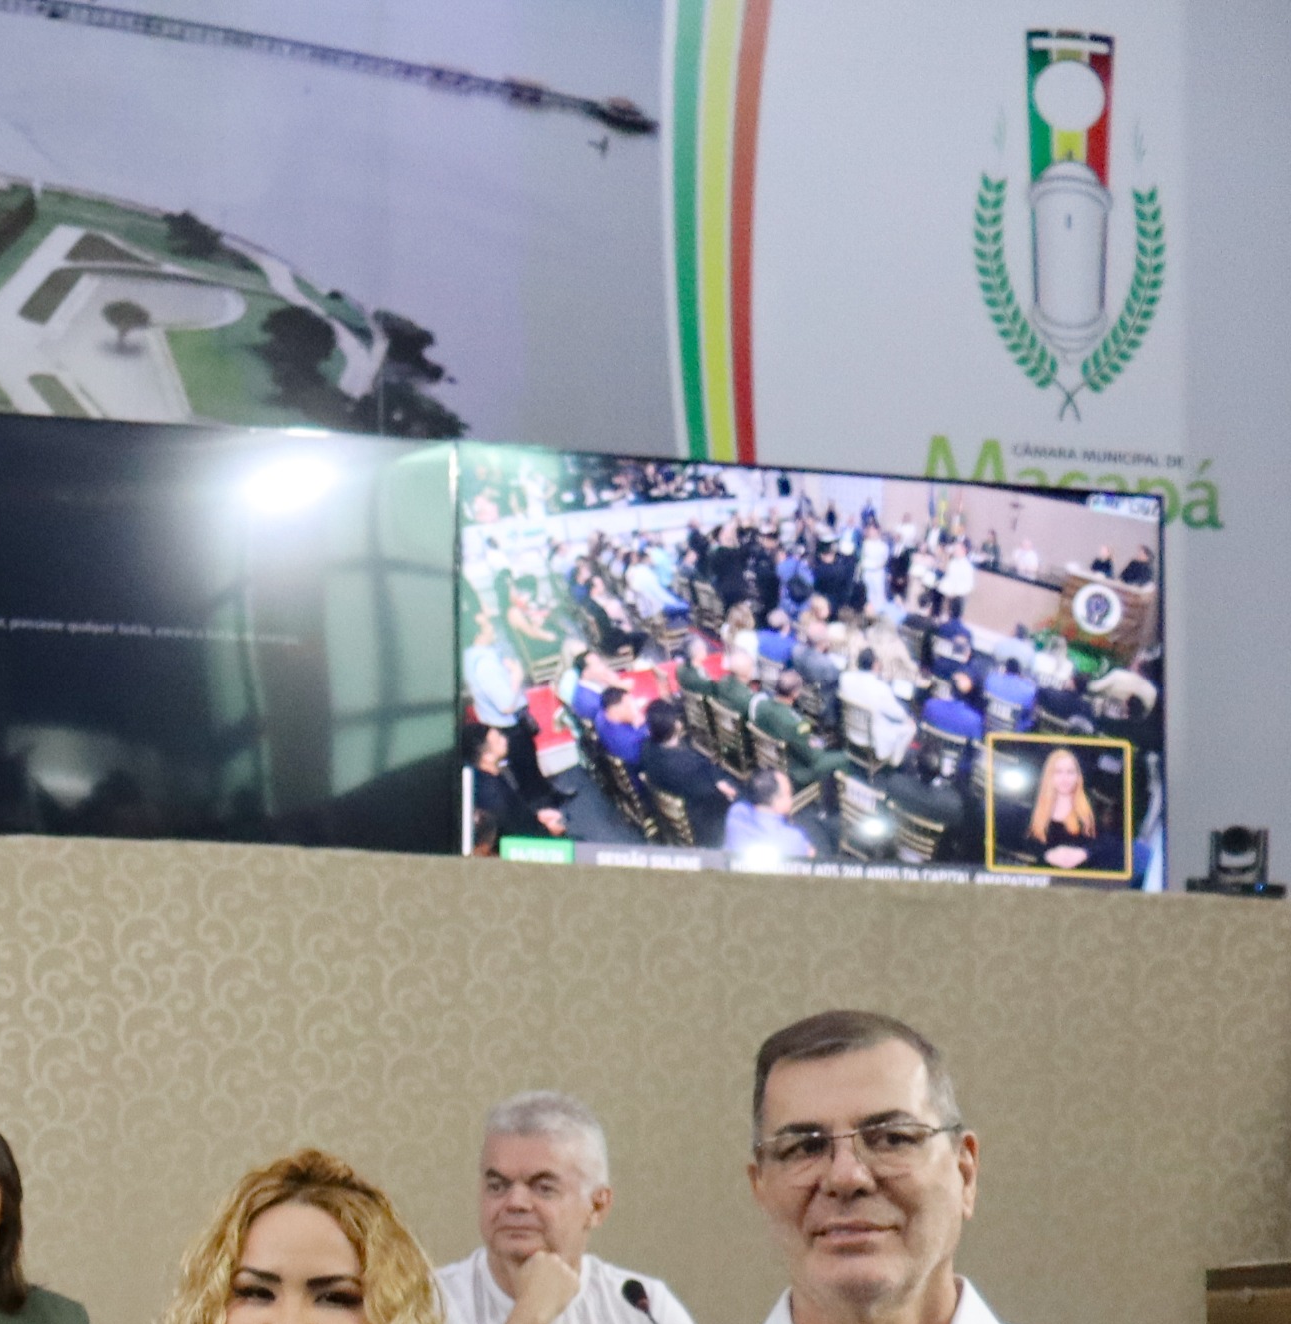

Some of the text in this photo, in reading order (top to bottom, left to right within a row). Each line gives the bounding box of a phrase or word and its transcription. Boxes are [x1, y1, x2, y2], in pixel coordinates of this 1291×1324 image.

[1012, 442, 1185, 468] CÂMARA MUNICIPAL DE
